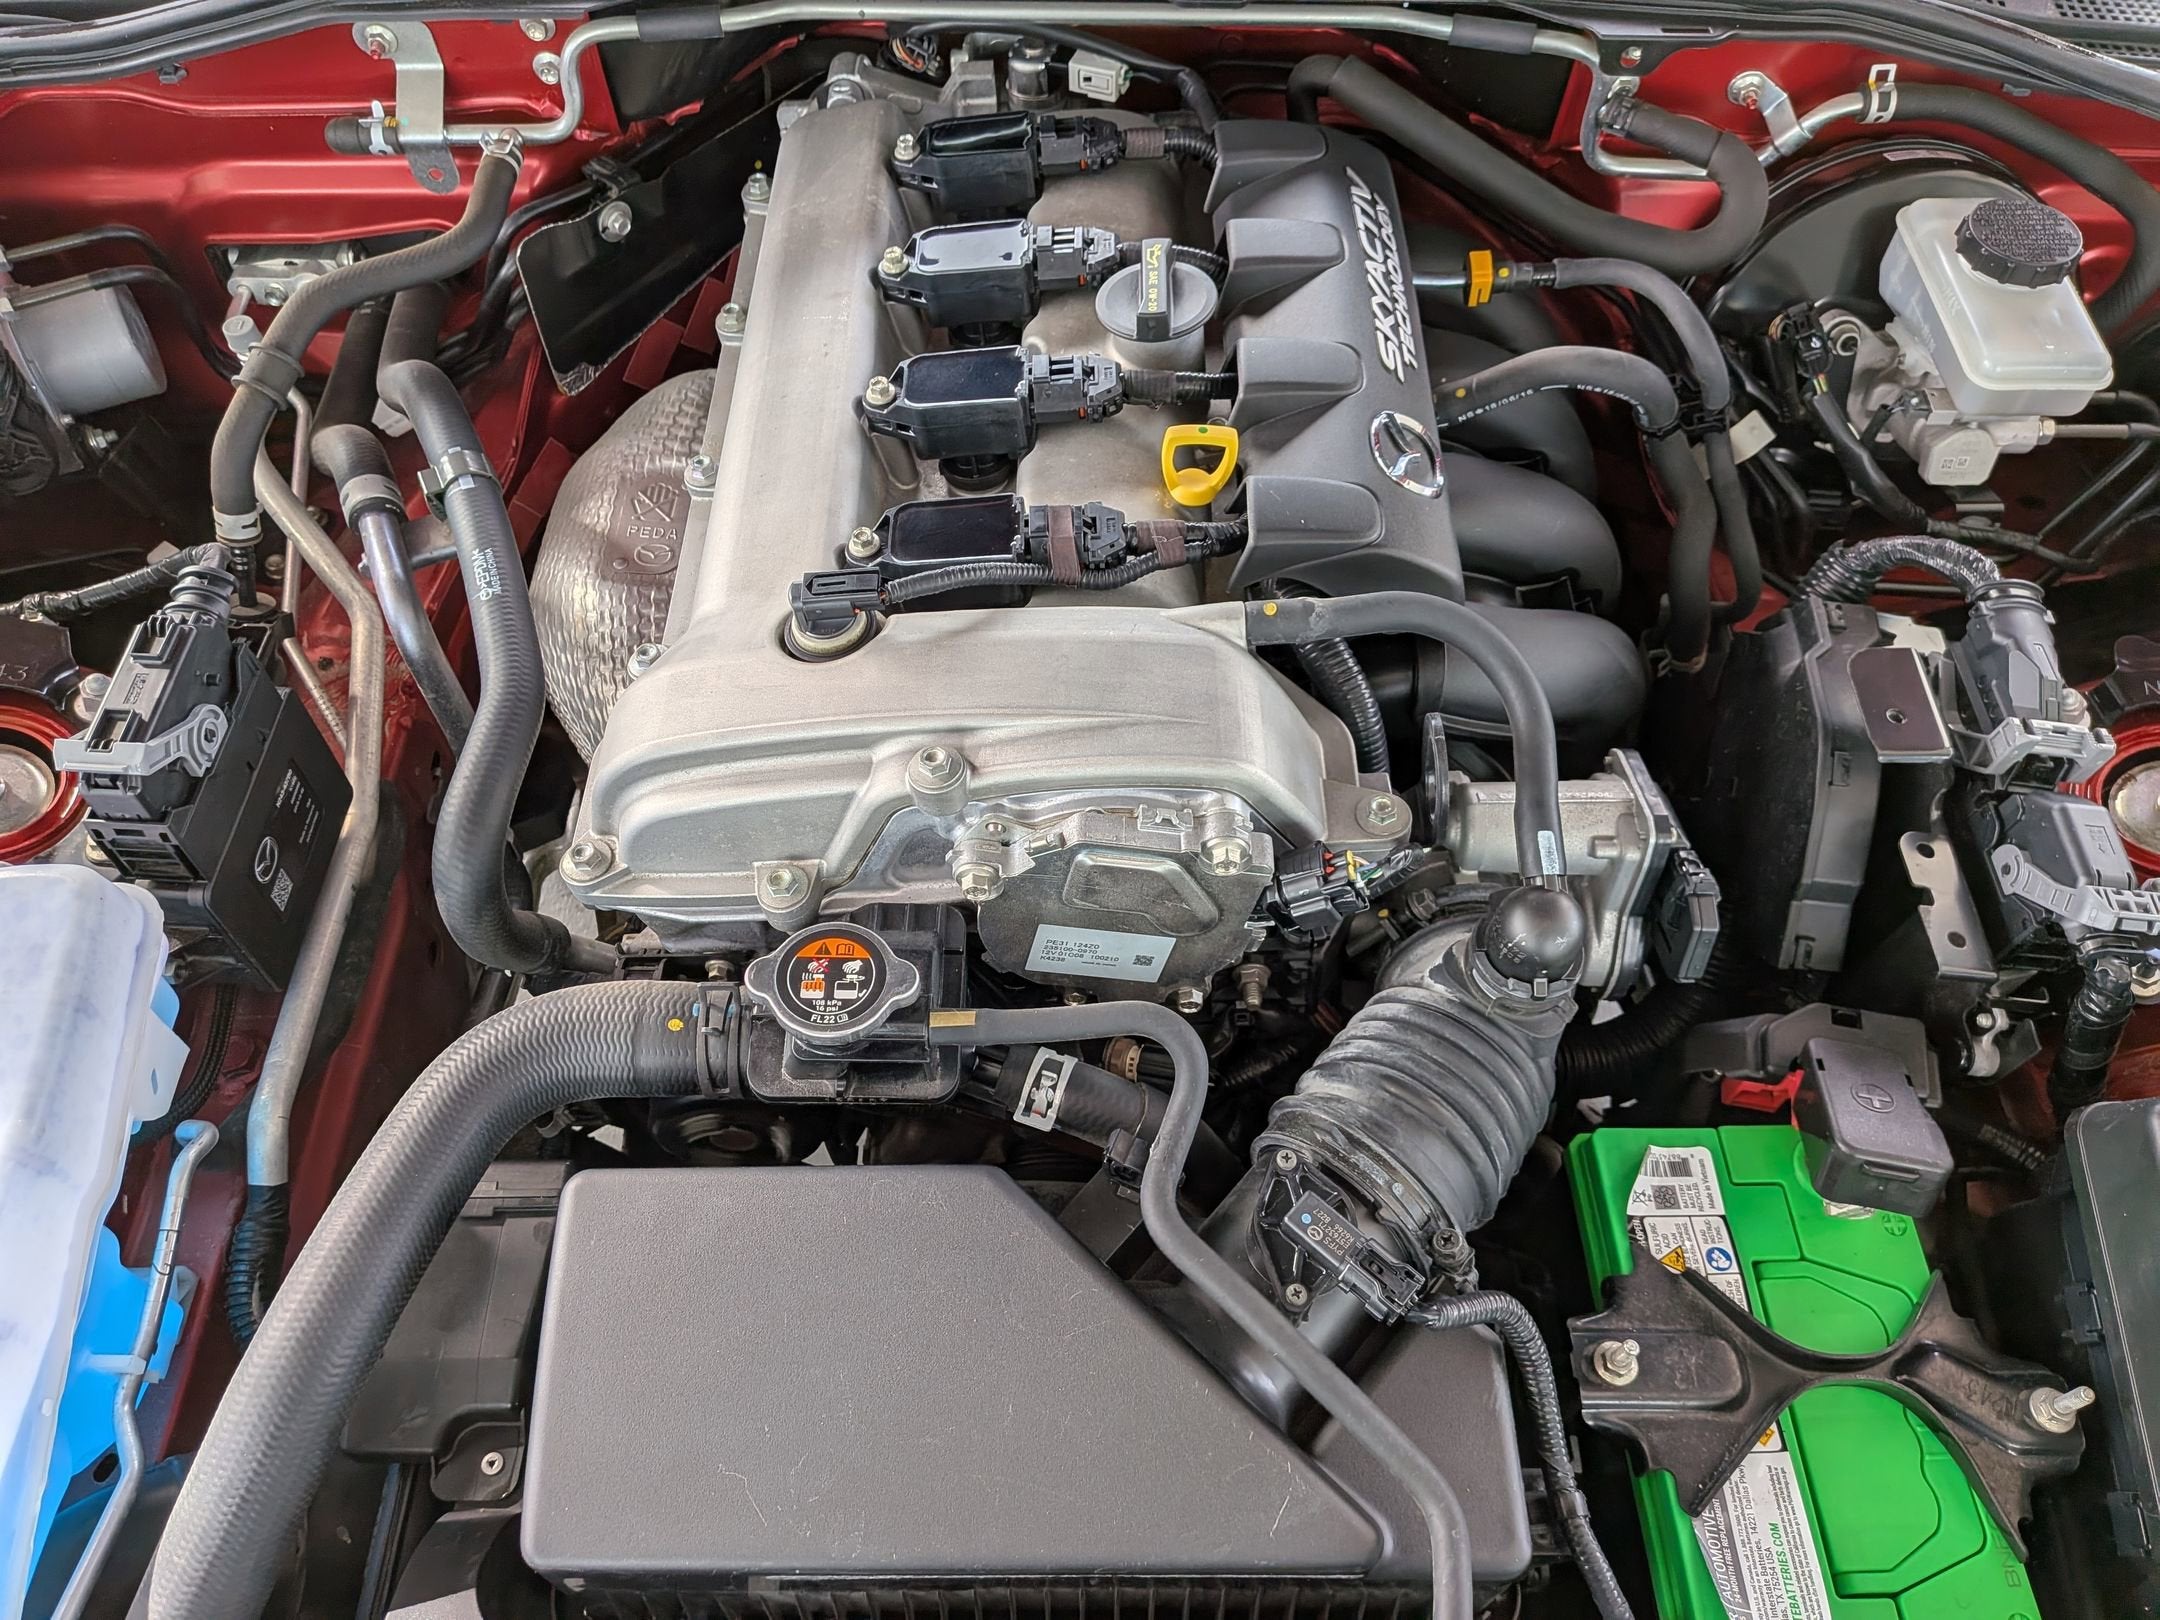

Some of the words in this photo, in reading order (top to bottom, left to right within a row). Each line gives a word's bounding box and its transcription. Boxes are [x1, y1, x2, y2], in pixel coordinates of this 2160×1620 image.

[1148, 270, 1158, 284] SAE
[1346, 166, 1404, 383] SKYACTIV
[1373, 192, 1418, 369] TECHNOLOGY
[1147, 288, 1157, 311] 0W-20
[626, 525, 677, 540] PEDA
[810, 1014, 835, 1024] FL22
[1697, 1157, 1709, 1184] Vietnam
[1677, 1182, 1689, 1209] BATTERY
[1684, 1183, 1692, 1193] BE
[1691, 1180, 1704, 1212] RECYCLED.
[1704, 1190, 1715, 1209] Made
[1687, 1194, 1696, 1209] MUST
[1323, 1236, 1345, 1256] PYFS
[1648, 1221, 1662, 1255] SULFURIC
[1661, 1232, 1671, 1249] ACID
[1670, 1231, 1679, 1244] CAN
[1699, 1228, 1709, 1245] READ
[1735, 1463, 1748, 1485] Pkwy
[1740, 1485, 1753, 1510] Dallas
[1711, 1496, 1729, 1547] REPLACEMENT
[1747, 1511, 1759, 1535] 14221
[1700, 1507, 1733, 1603] AUTOMOTIVE
[1722, 1546, 1733, 1565] FREE
[1752, 1537, 1769, 1577] Batteries,
[1763, 1546, 1775, 1565] USA
[1726, 1563, 1742, 1603] 24-MONTH
[1768, 1565, 1781, 1592] 75254
[1761, 1576, 1778, 1619] Interstate
[1775, 1592, 1785, 1604] TX
